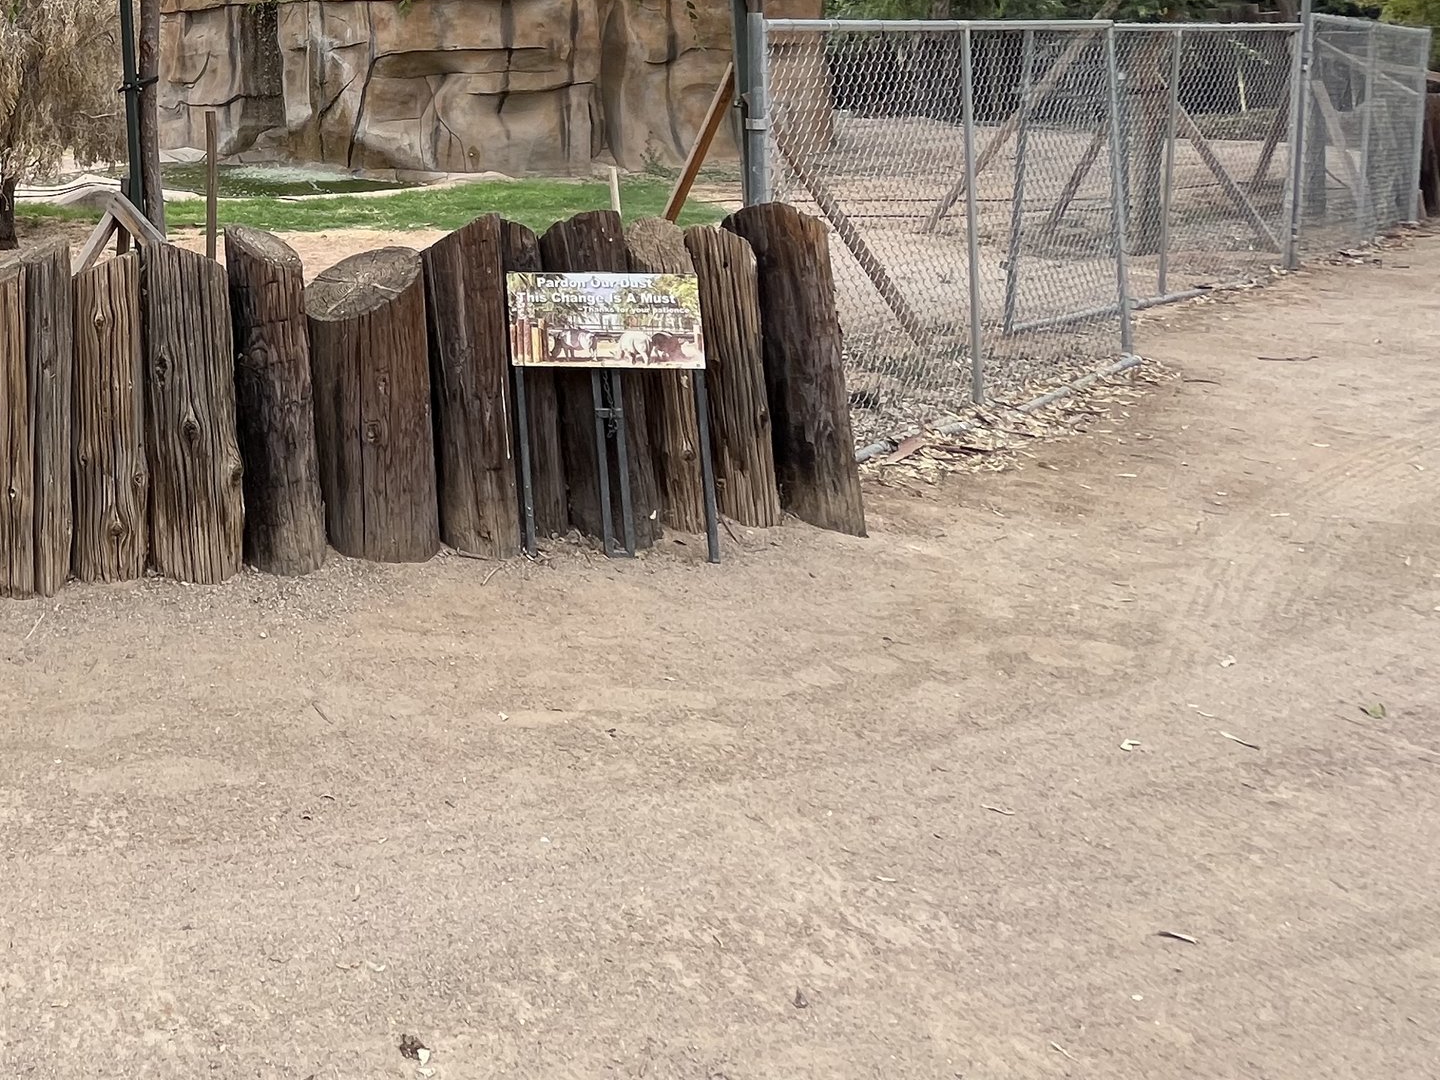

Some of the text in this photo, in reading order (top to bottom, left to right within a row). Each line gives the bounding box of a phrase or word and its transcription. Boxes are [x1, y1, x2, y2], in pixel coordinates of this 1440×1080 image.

[536, 277, 654, 289] Pardon Our Dust
[516, 291, 676, 306] This Change Is A Must
[630, 307, 651, 316] your
[652, 306, 690, 315] patience
